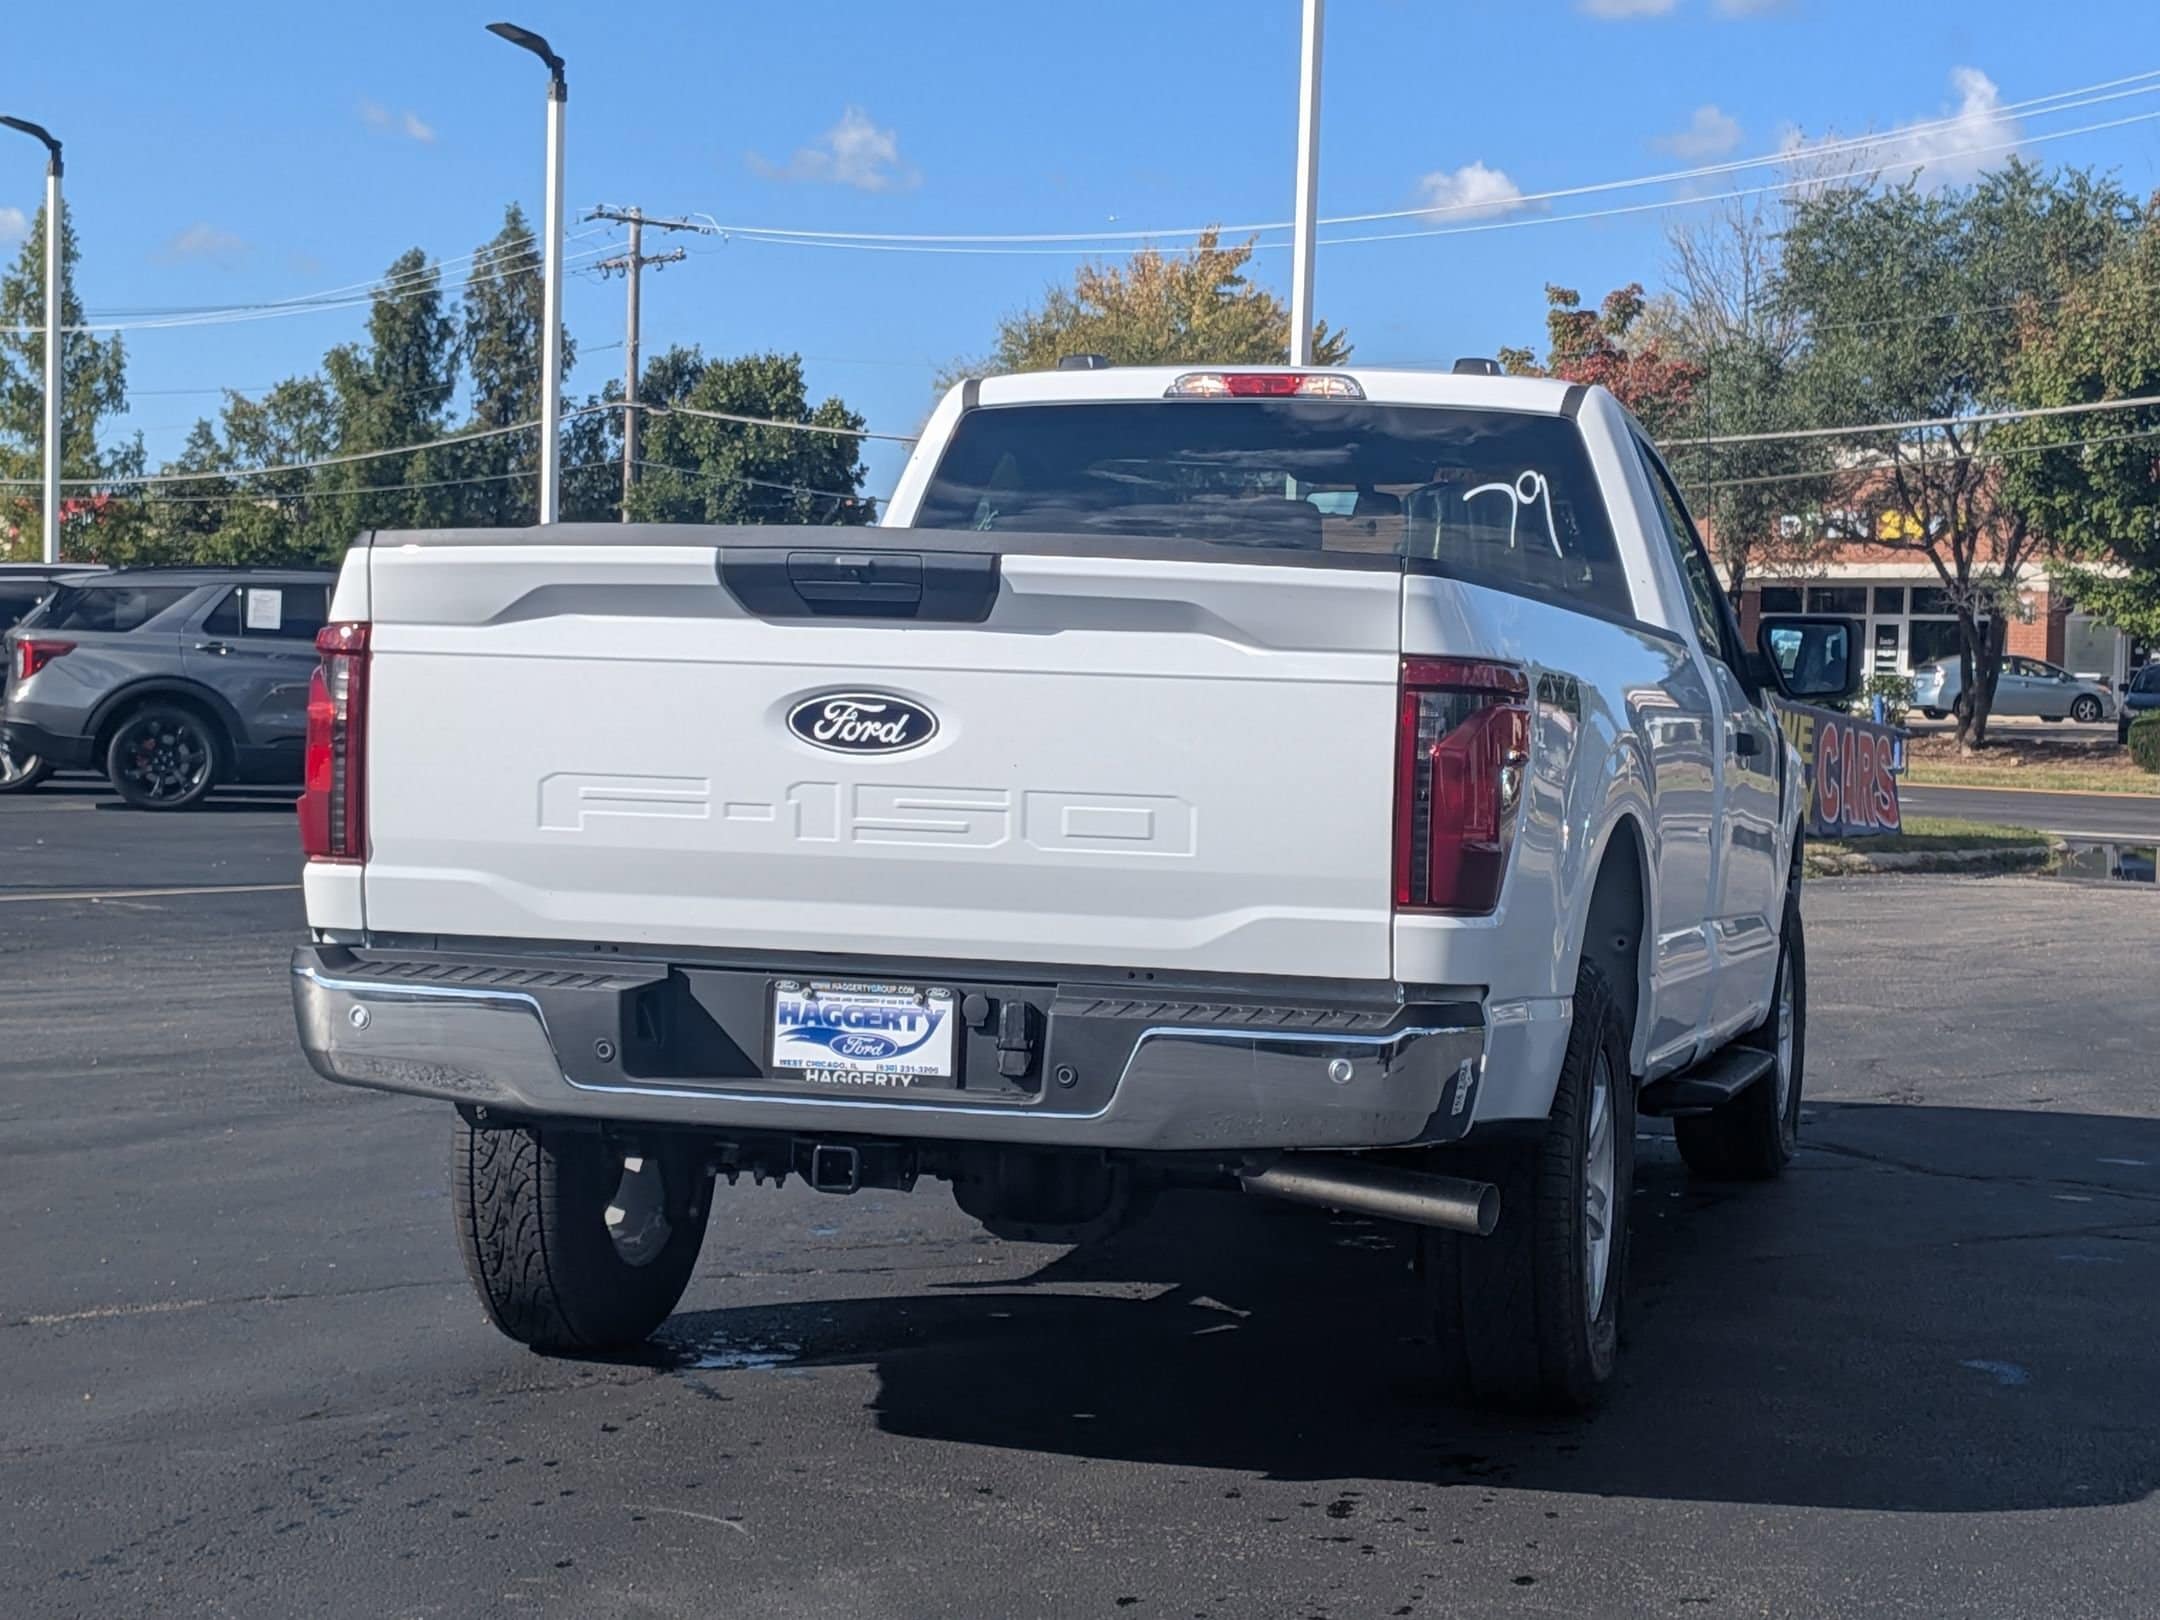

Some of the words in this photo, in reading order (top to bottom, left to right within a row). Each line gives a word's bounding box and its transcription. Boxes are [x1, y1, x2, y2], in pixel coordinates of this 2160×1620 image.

[813, 700, 910, 744] Ford
[1817, 721, 1900, 830] CARS
[537, 770, 1199, 859] F-150
[778, 1001, 947, 1033] HAGGERTY
[842, 1035, 884, 1056] Ford
[780, 1059, 802, 1067] WEST
[805, 1069, 913, 1088] HAGGERTY
